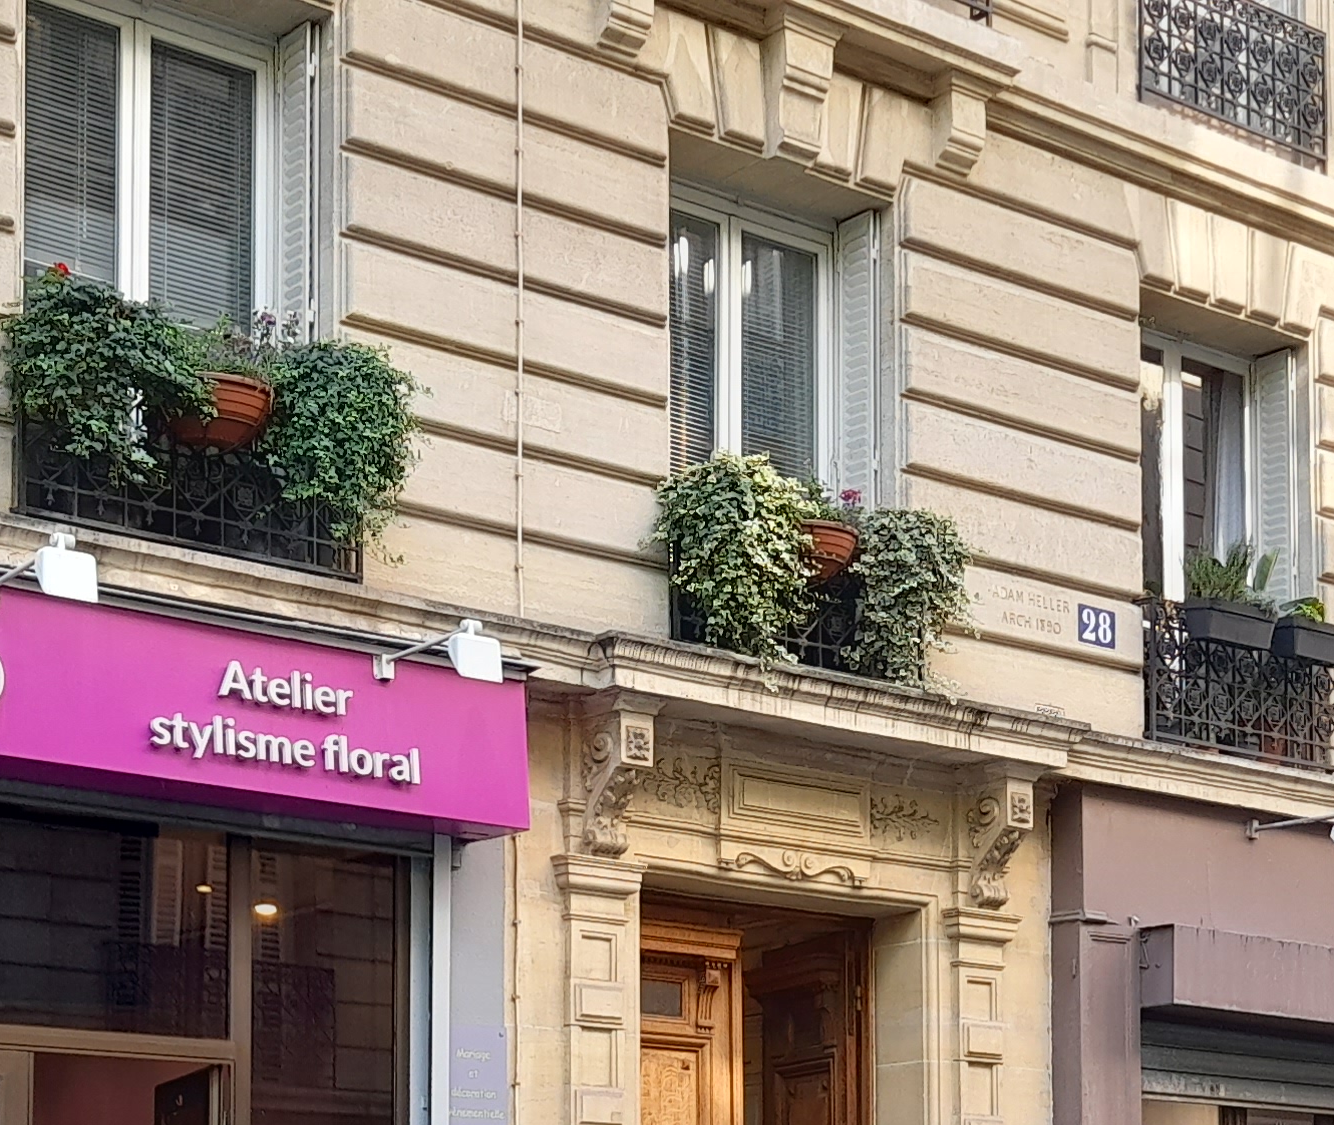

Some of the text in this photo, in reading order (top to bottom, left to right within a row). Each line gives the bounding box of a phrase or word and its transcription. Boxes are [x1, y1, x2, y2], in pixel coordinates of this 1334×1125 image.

[1028, 592, 1070, 614] HELLER
[1001, 611, 1062, 635] ARCH 1890
[1081, 608, 1112, 644] 28
[217, 660, 353, 716] Atelier
[149, 712, 422, 785] stylisme floral
[456, 1048, 491, 1062] Mariage
[468, 1069, 479, 1078] et
